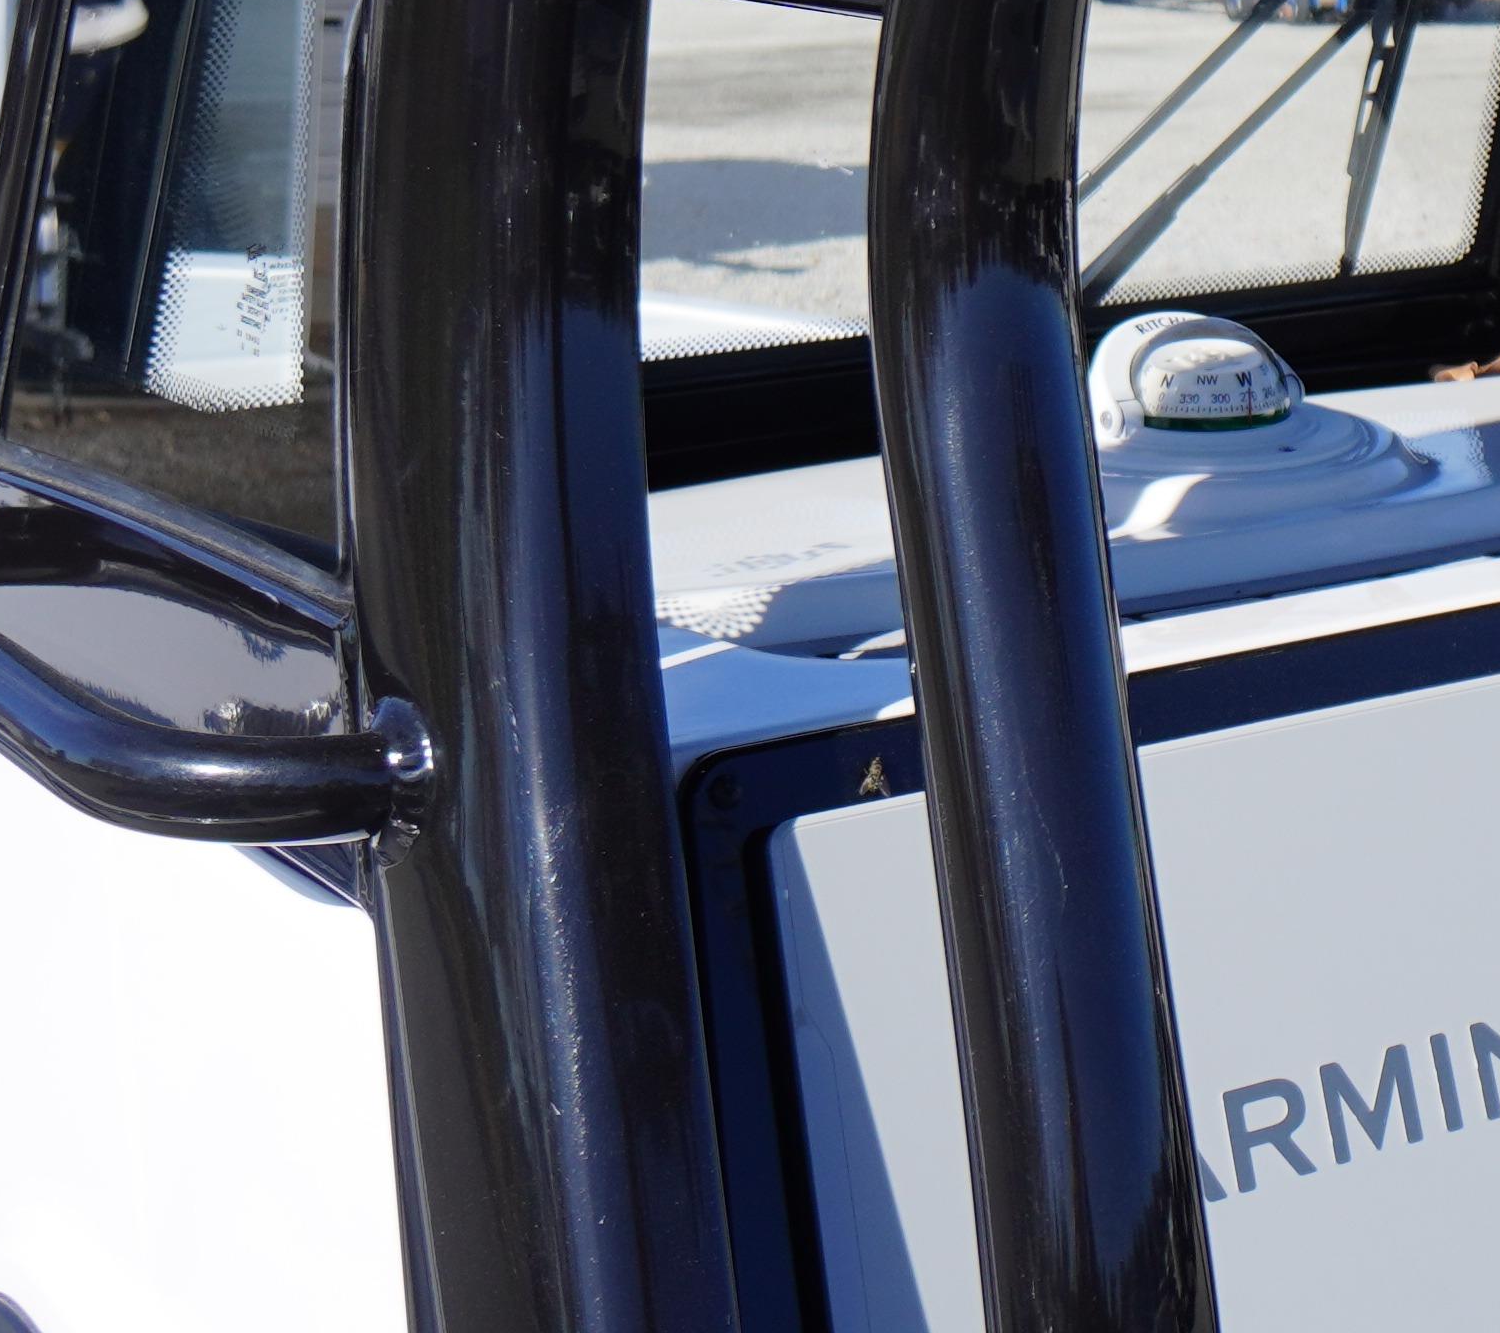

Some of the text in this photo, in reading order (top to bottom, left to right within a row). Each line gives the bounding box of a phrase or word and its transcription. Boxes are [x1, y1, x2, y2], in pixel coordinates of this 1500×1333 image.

[1160, 371, 1253, 388] N NW W
[1179, 393, 1200, 405] 330
[1211, 393, 1231, 404] 300
